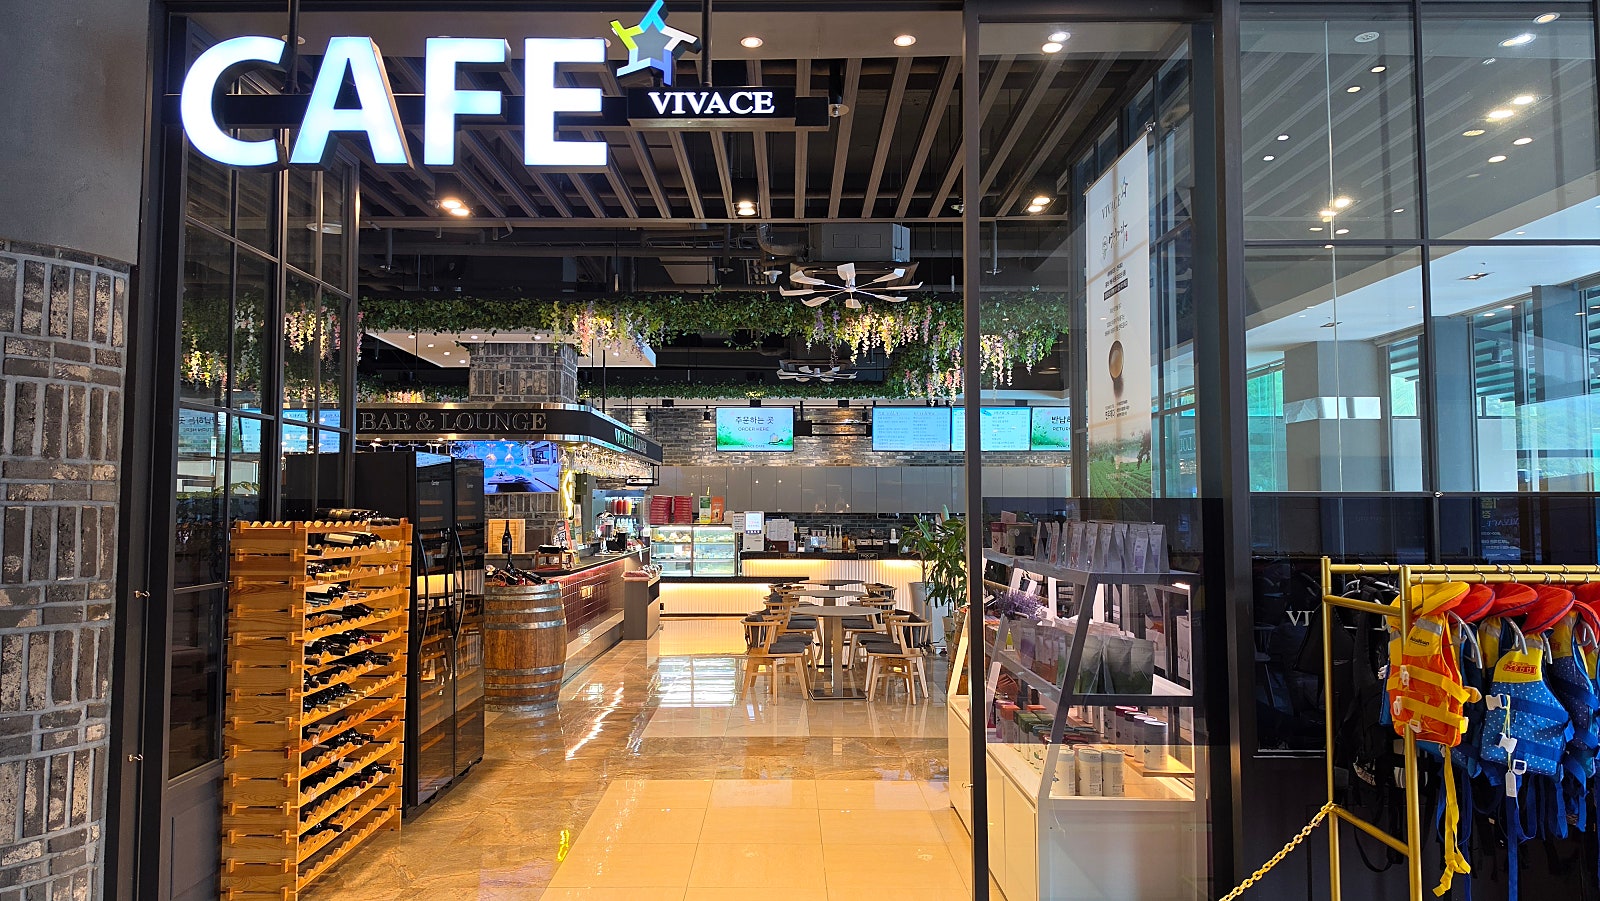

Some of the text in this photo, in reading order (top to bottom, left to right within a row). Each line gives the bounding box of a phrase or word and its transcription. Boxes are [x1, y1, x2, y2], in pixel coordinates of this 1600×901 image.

[180, 36, 608, 167] CAFE
[647, 91, 775, 115] VIVACE
[359, 412, 411, 431] BAR
[415, 412, 435, 431] &
[440, 412, 547, 431] LOUNGE
[736, 416, 774, 424] 주문하는 곳
